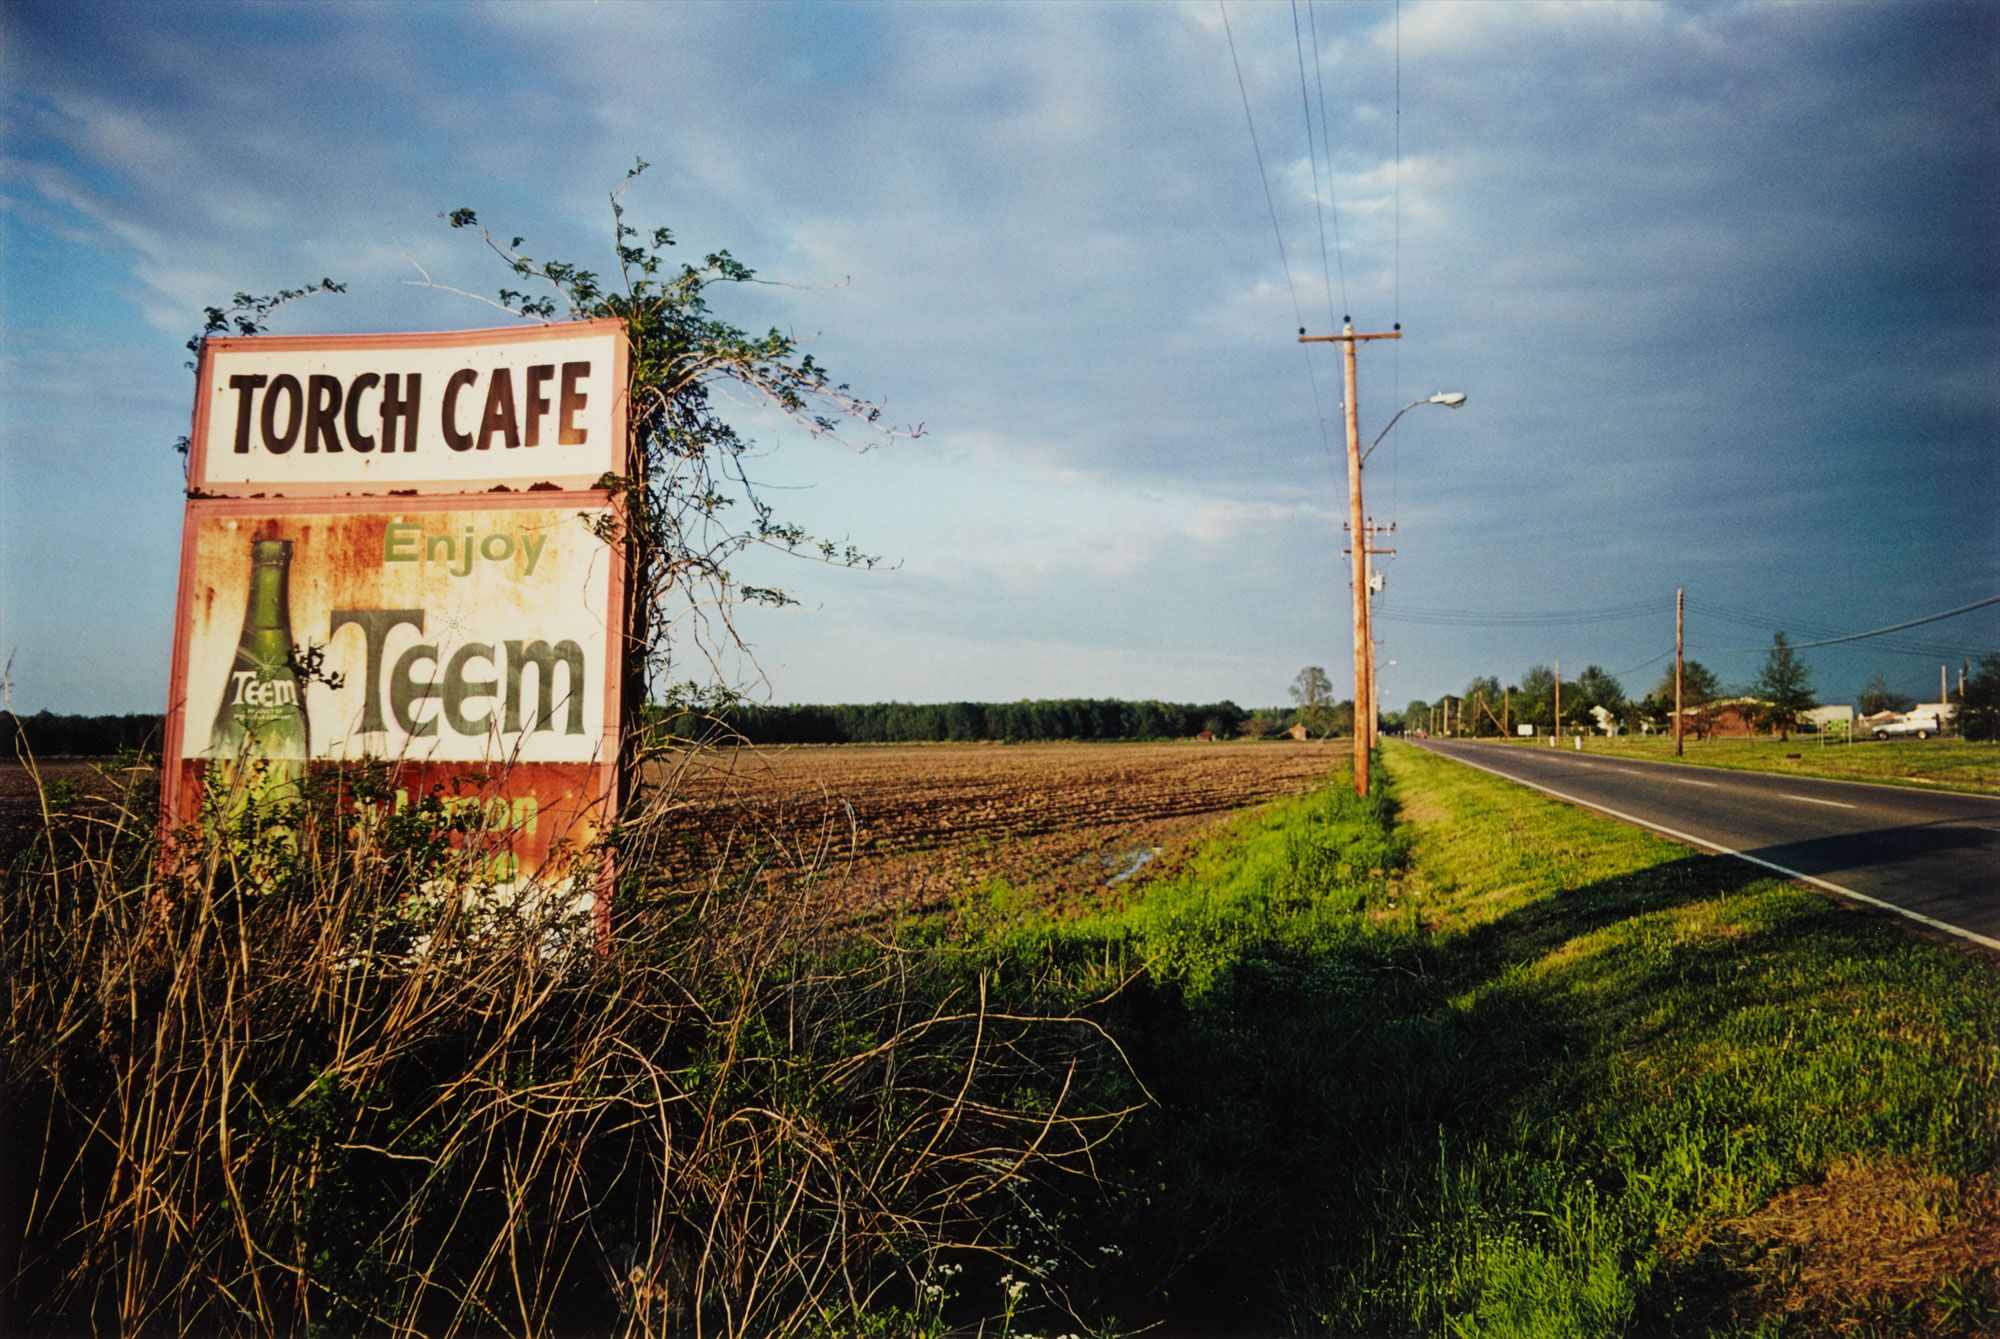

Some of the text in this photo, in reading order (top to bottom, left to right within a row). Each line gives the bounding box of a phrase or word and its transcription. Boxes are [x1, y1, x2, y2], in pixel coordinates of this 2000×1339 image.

[229, 360, 592, 455] TORCH CAFE
[383, 522, 548, 577] Enjoy
[230, 671, 299, 708] Teem
[329, 608, 586, 737] Teem
